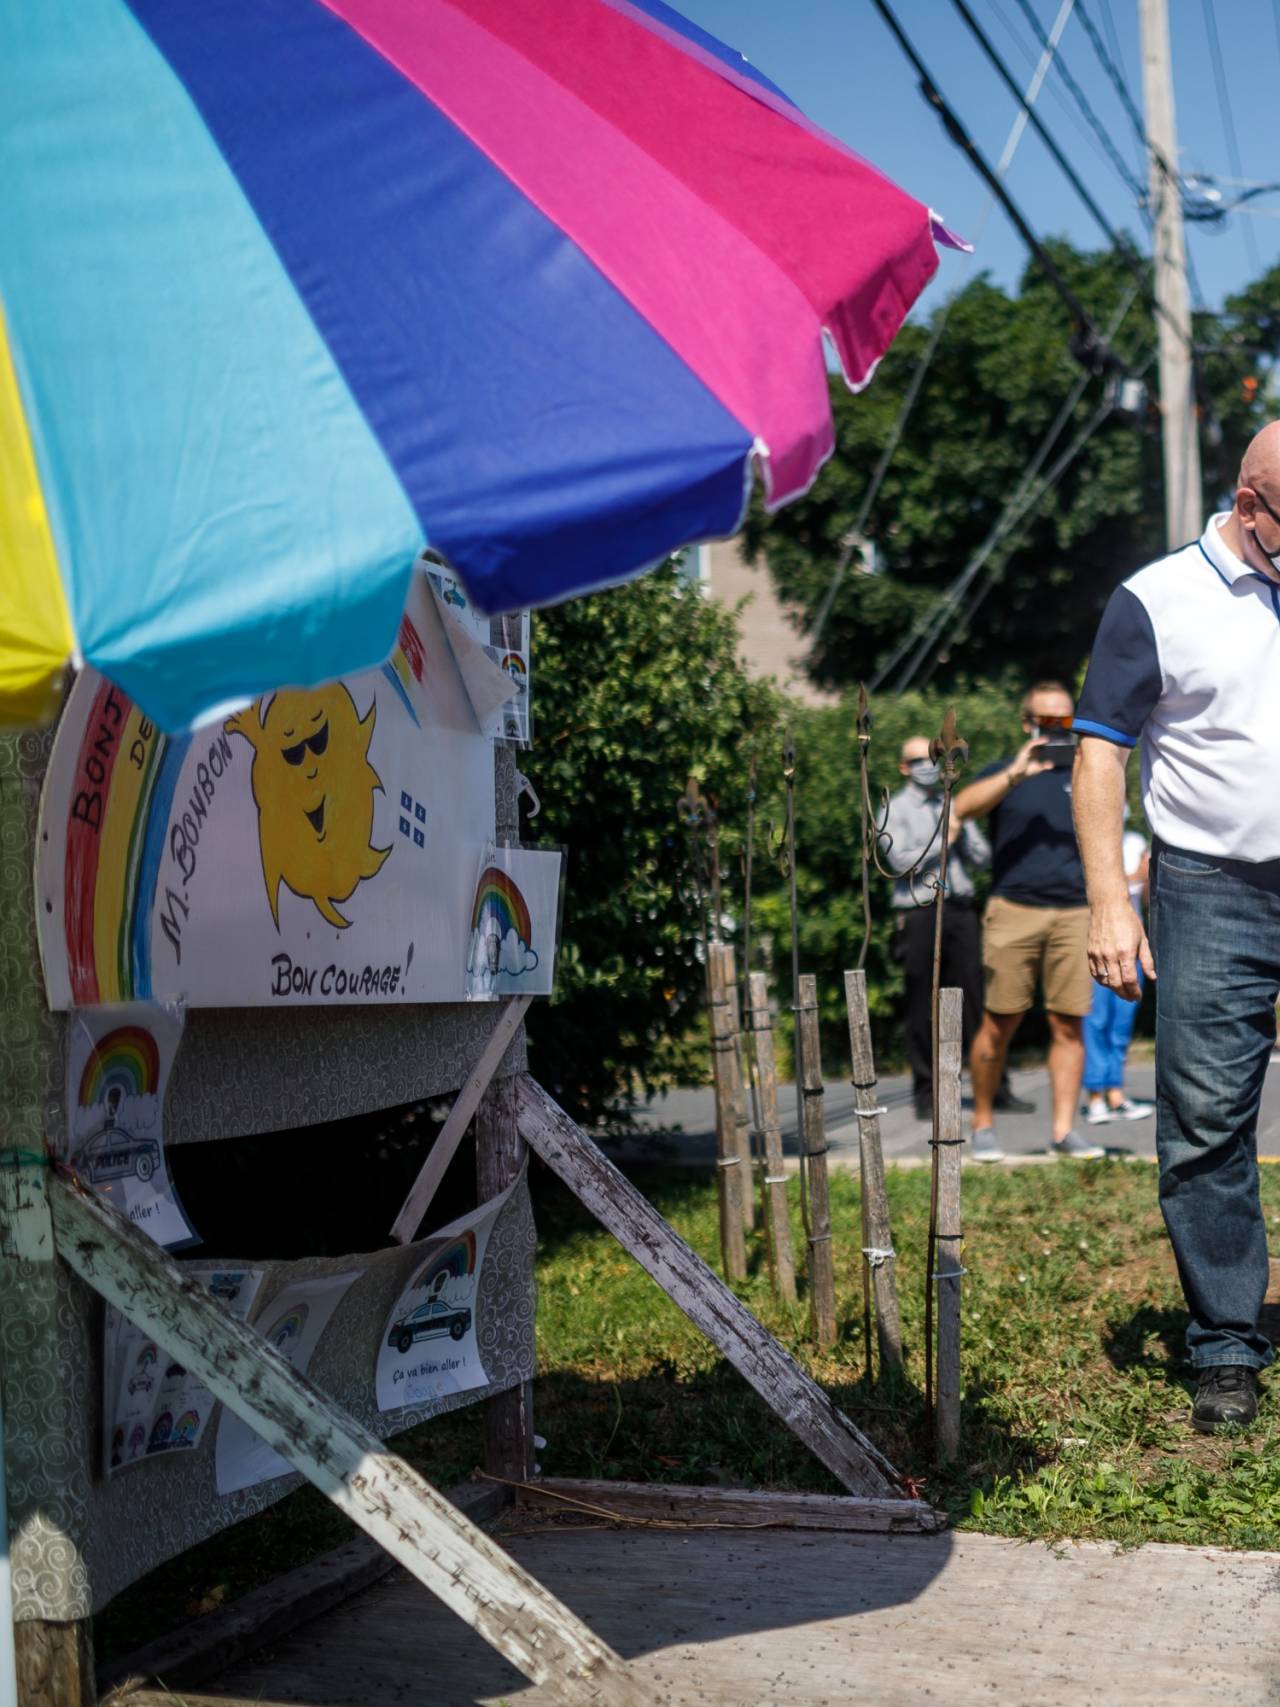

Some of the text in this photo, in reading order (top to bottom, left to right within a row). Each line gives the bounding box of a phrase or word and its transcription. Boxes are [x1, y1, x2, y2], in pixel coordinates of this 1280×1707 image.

[160, 731, 234, 966] M. BONBON
[271, 952, 318, 997] BON
[407, 1368, 418, 1378] va
[420, 1363, 438, 1376] bien
[441, 1358, 460, 1371] aller
